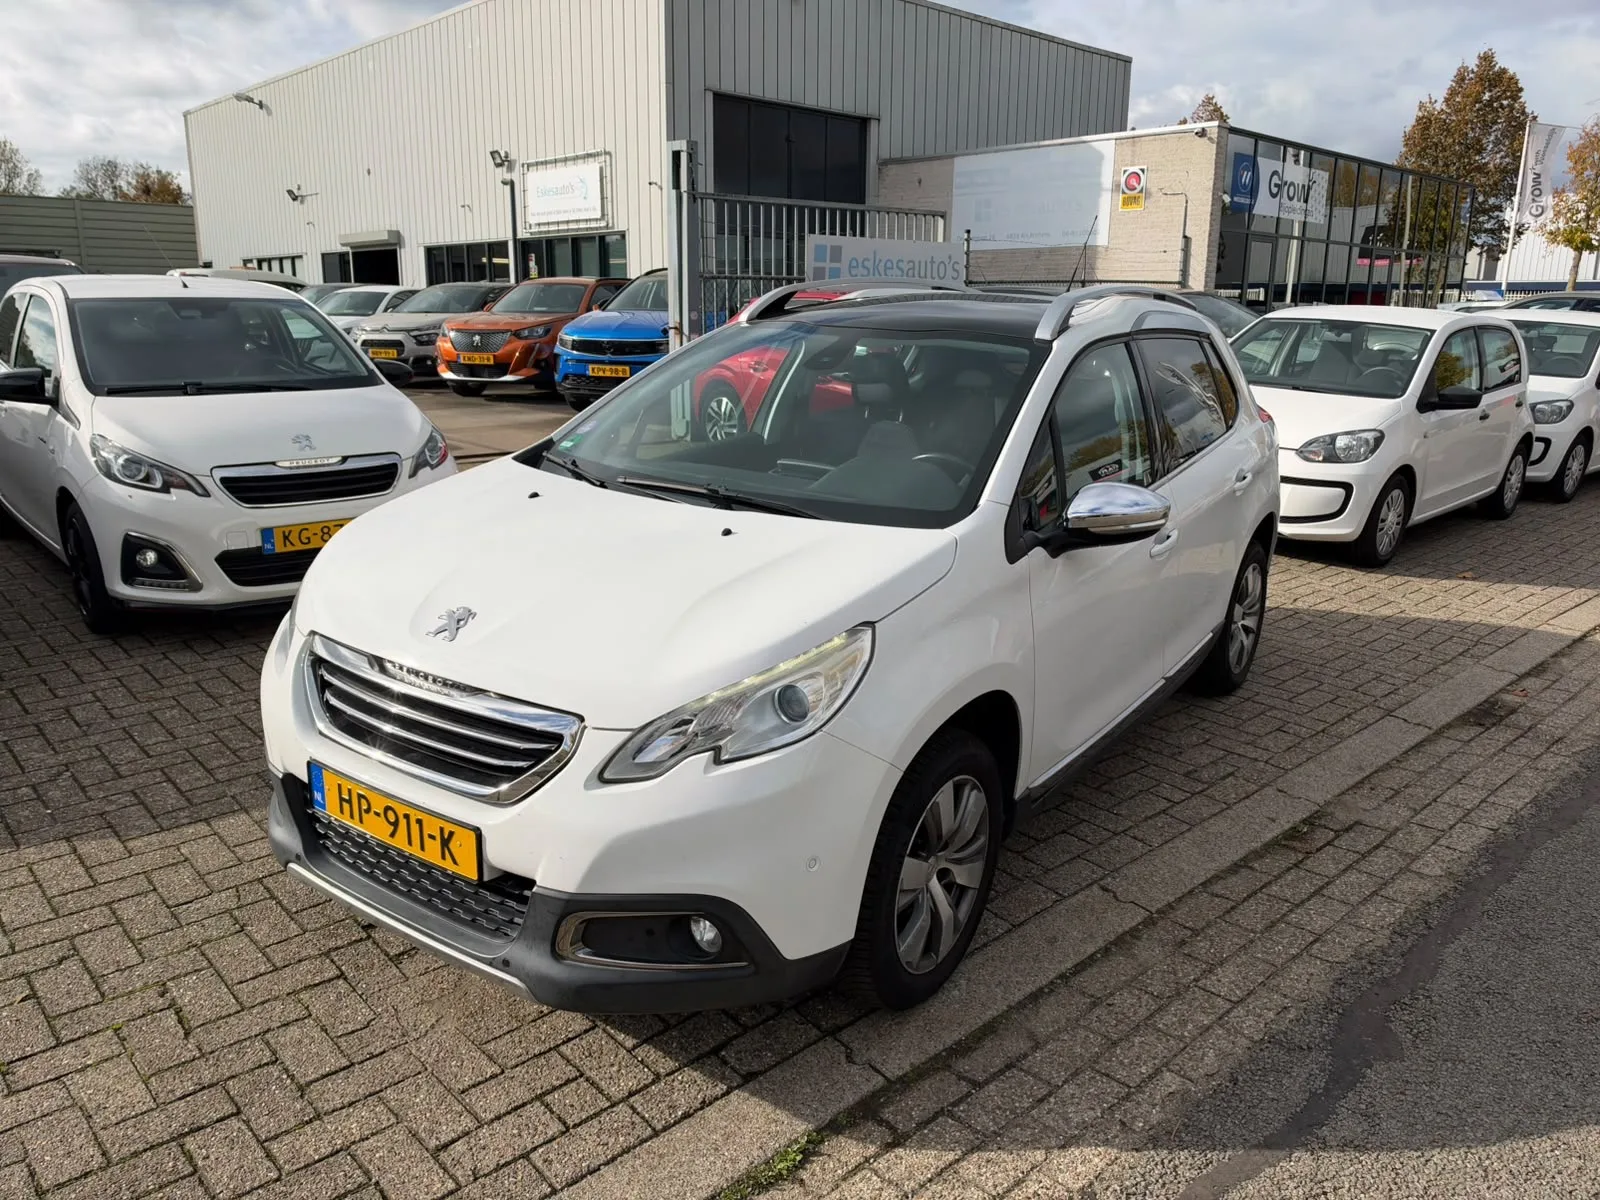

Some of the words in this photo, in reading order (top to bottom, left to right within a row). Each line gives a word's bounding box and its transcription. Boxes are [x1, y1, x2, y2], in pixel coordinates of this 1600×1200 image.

[1268, 169, 1310, 204] Grow
[1529, 173, 1544, 218] Grow
[848, 251, 960, 281] eskesauto's
[314, 790, 325, 803] NL
[336, 781, 460, 867] HP-911-K
